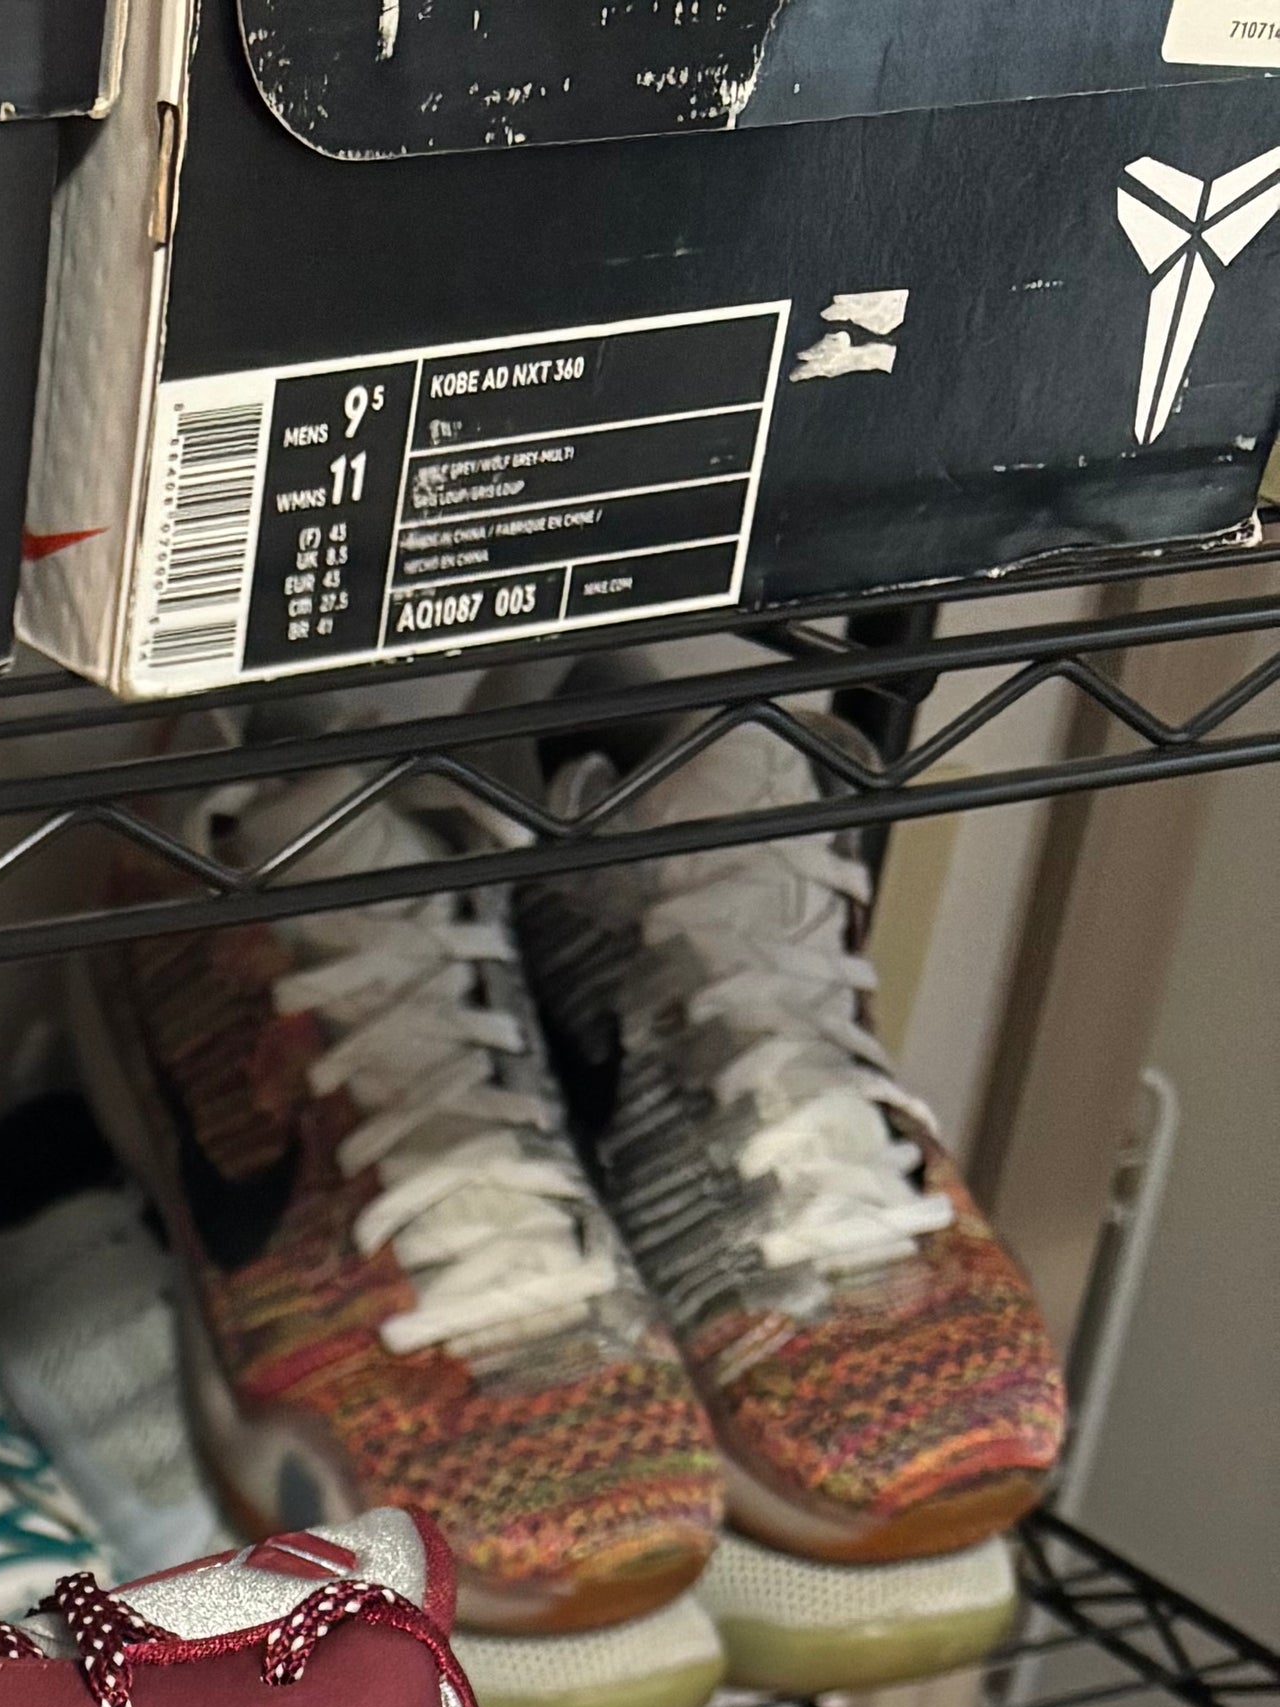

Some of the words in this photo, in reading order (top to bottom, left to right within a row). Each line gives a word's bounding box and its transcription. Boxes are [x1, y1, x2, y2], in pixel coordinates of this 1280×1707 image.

[430, 370, 479, 398] KOBE
[482, 366, 509, 391] AD
[512, 360, 552, 387] NXT
[553, 356, 585, 381] 360
[283, 423, 329, 448] MENS
[276, 487, 326, 513] WMNS
[330, 450, 367, 505] 11
[284, 573, 315, 596] EUR
[396, 590, 484, 633] AQ1087
[495, 584, 536, 617] 003
